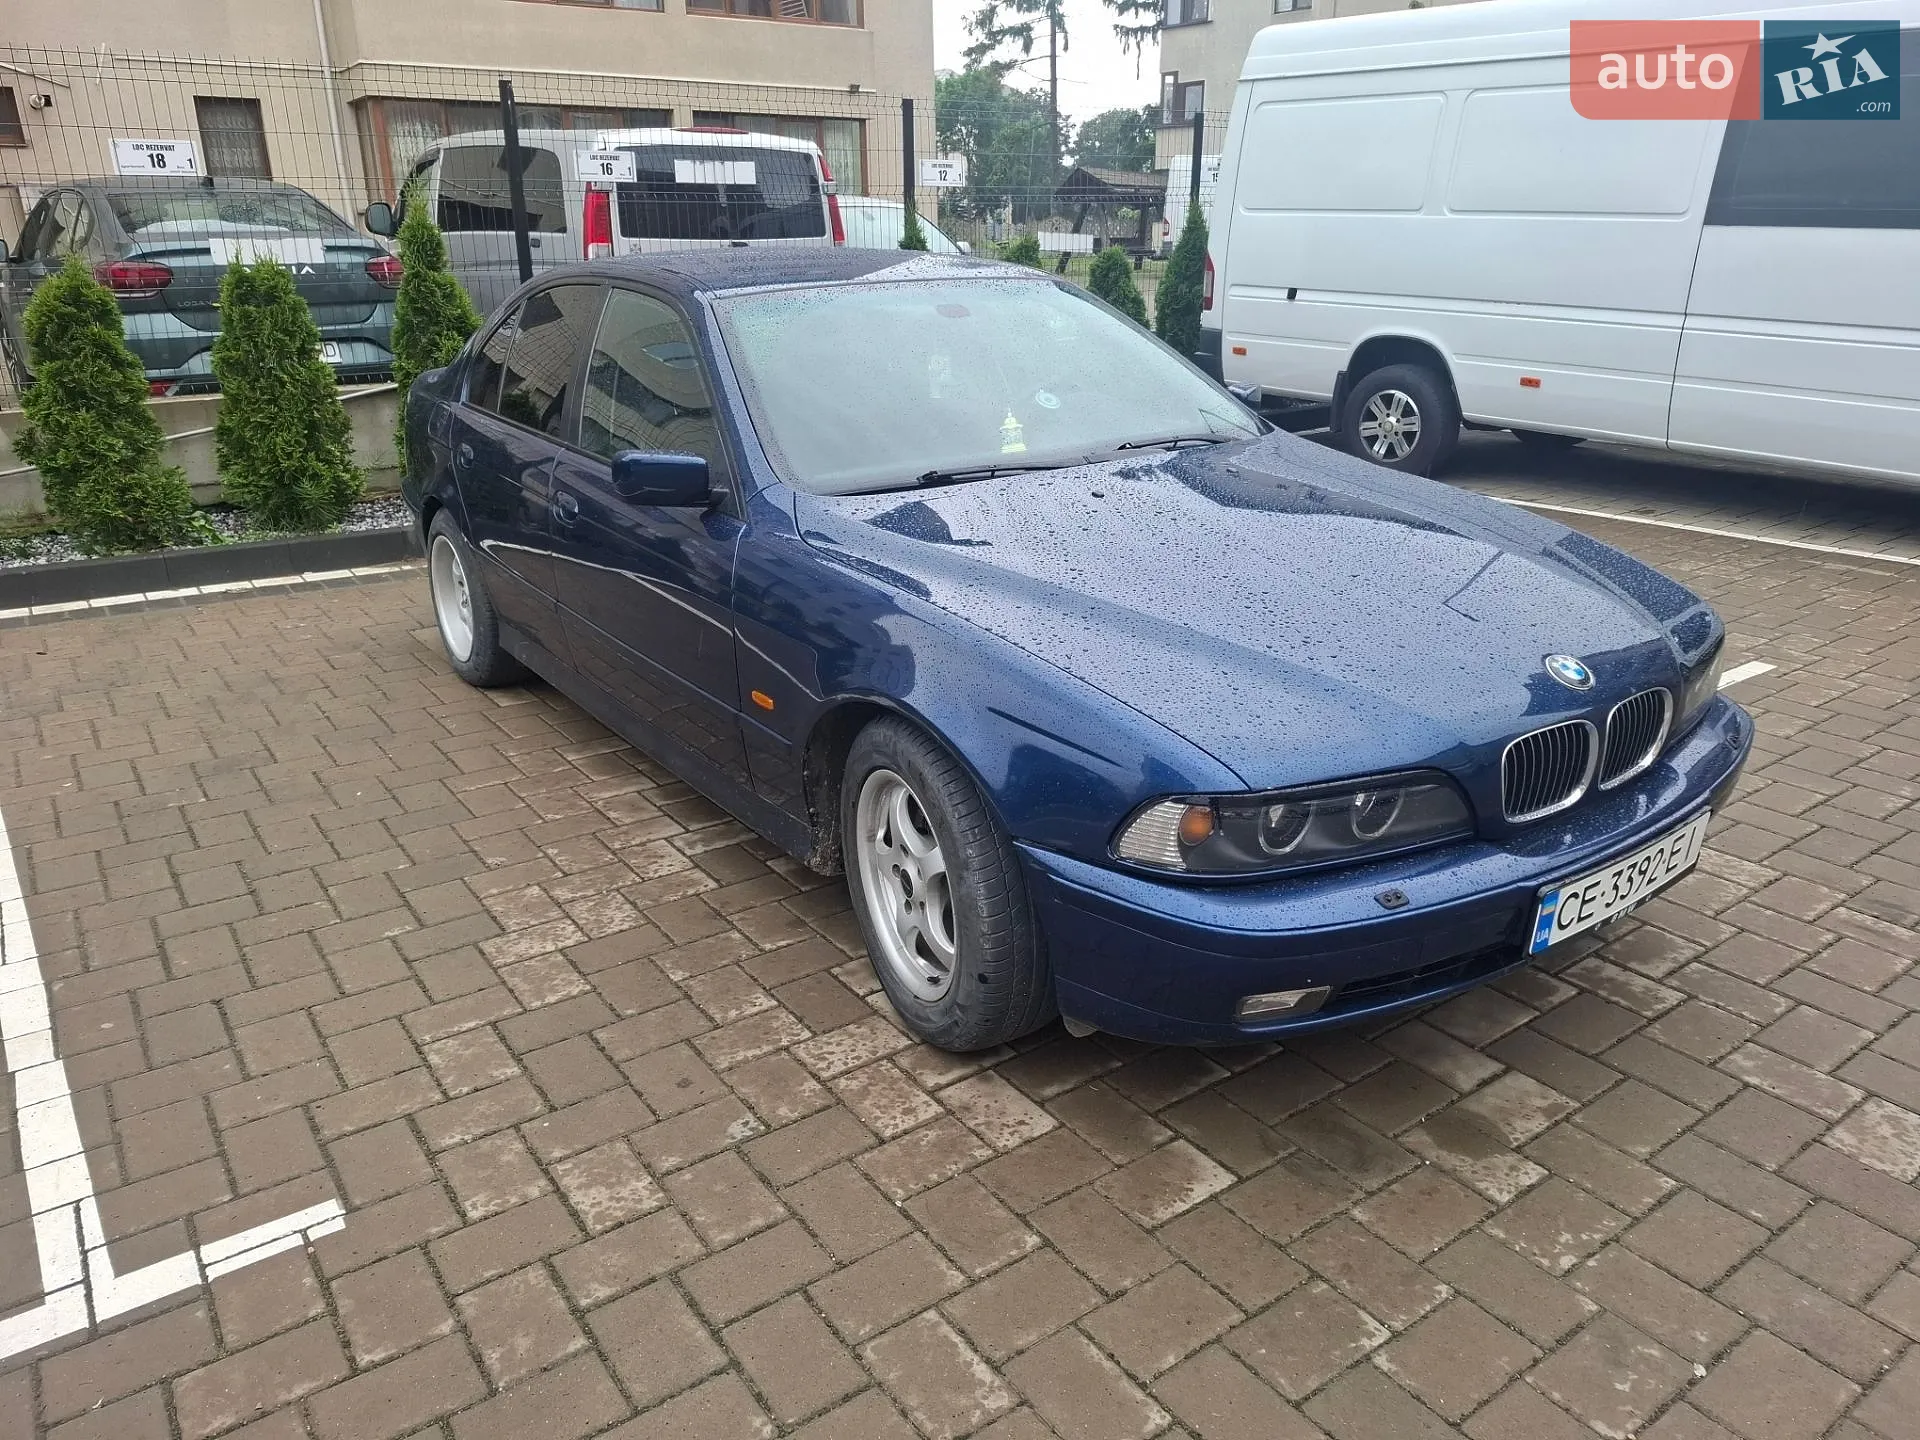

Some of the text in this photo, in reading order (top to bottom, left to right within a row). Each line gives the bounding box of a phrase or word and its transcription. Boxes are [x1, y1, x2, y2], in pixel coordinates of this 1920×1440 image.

[147, 153, 167, 169] 18
[187, 158, 193, 169] 1
[600, 162, 613, 176] 16
[938, 170, 947, 181] 12
[1536, 929, 1549, 943] UA
